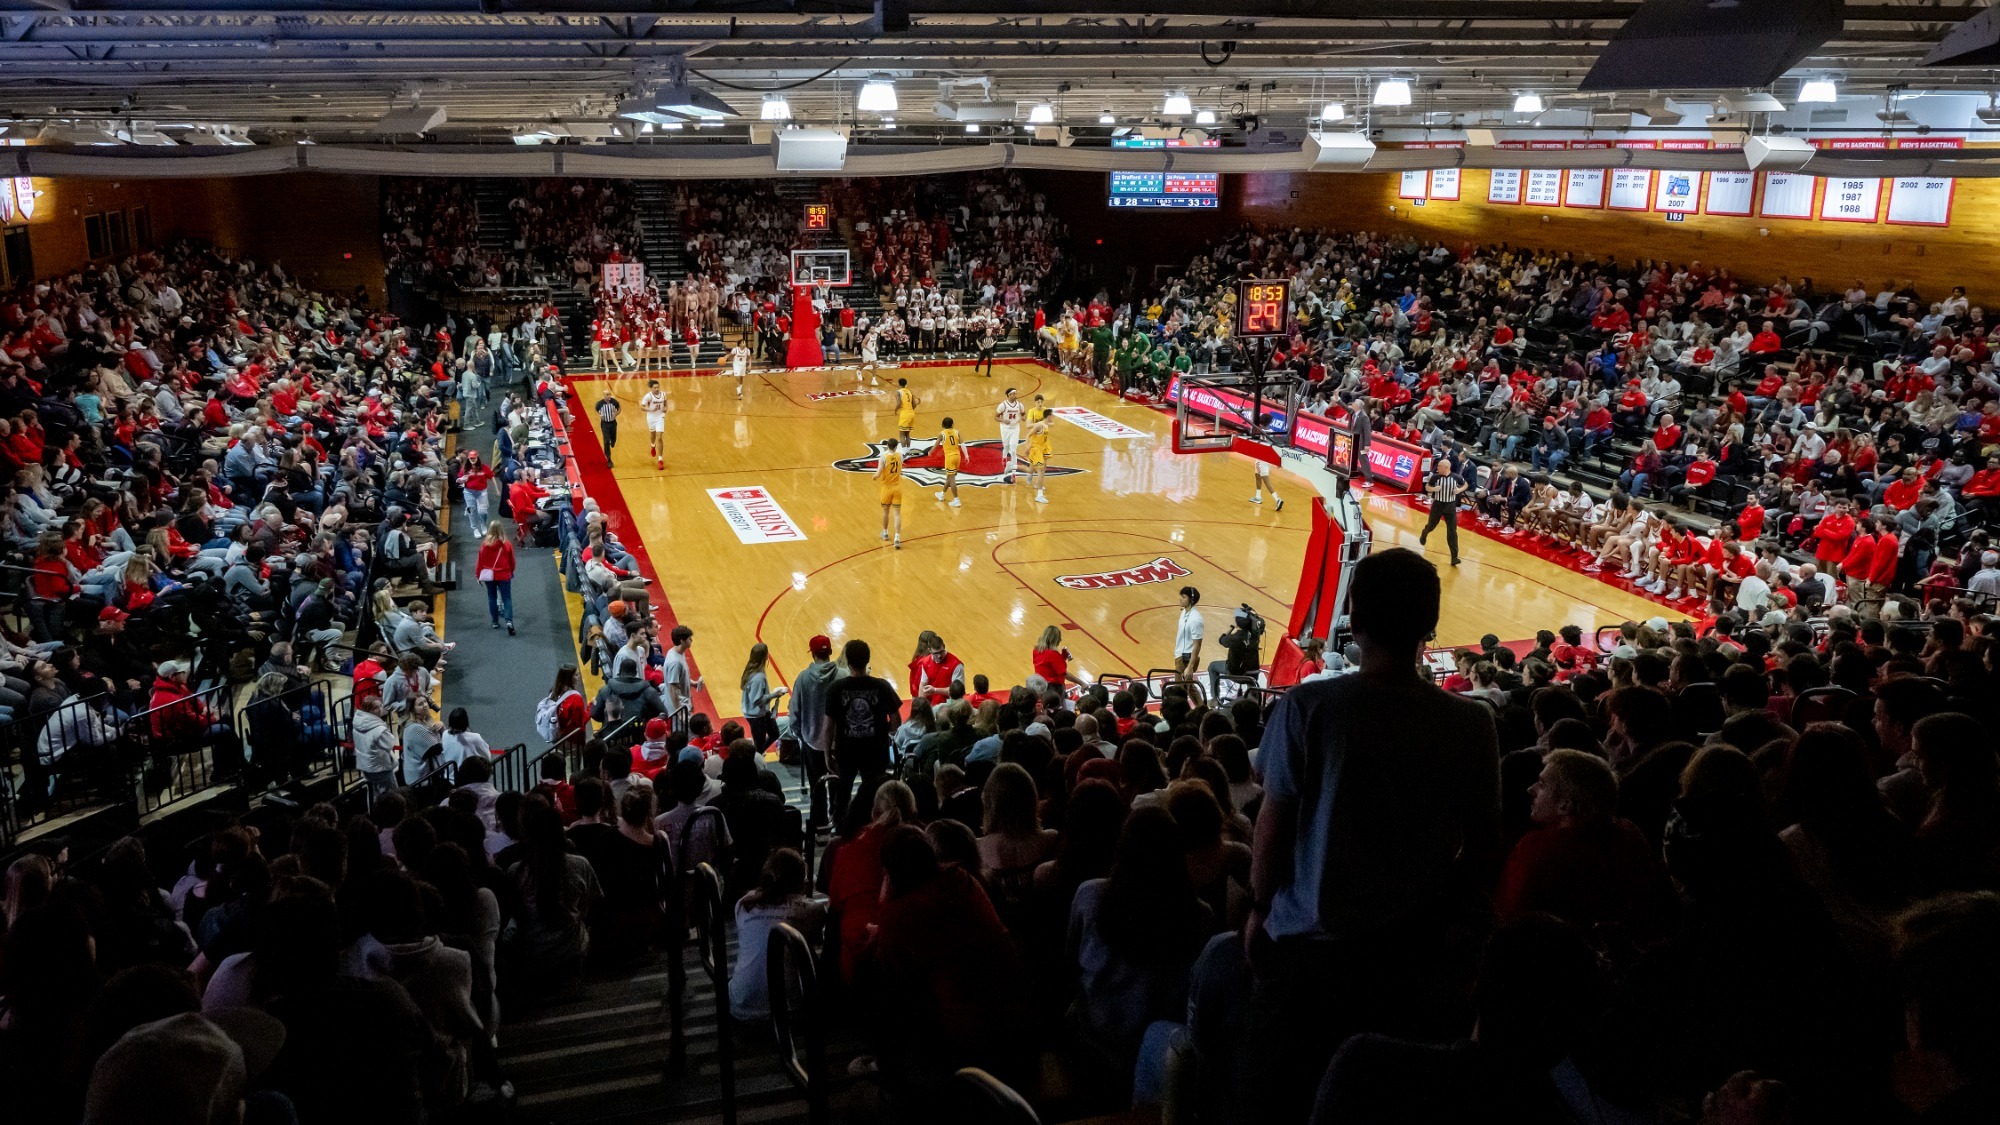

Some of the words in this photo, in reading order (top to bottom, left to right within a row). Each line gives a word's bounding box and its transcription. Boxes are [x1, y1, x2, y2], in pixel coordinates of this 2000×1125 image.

[810, 215, 823, 227] 29
[1250, 286, 1283, 300] 18:53
[1249, 303, 1277, 329] 29
[906, 393, 910, 402] 3
[1182, 388, 1197, 400] MAC
[1196, 392, 1224, 410] BASKETBALL
[950, 435, 955, 445] 0
[1296, 426, 1329, 447] MAACSPOR
[1282, 449, 1302, 462] SPALDING
[1367, 450, 1393, 469] ETBALL
[890, 461, 898, 473] 21
[722, 502, 752, 531] UNIVERSITY
[741, 500, 797, 538] MARIST
[1055, 558, 1192, 590] MAAC
